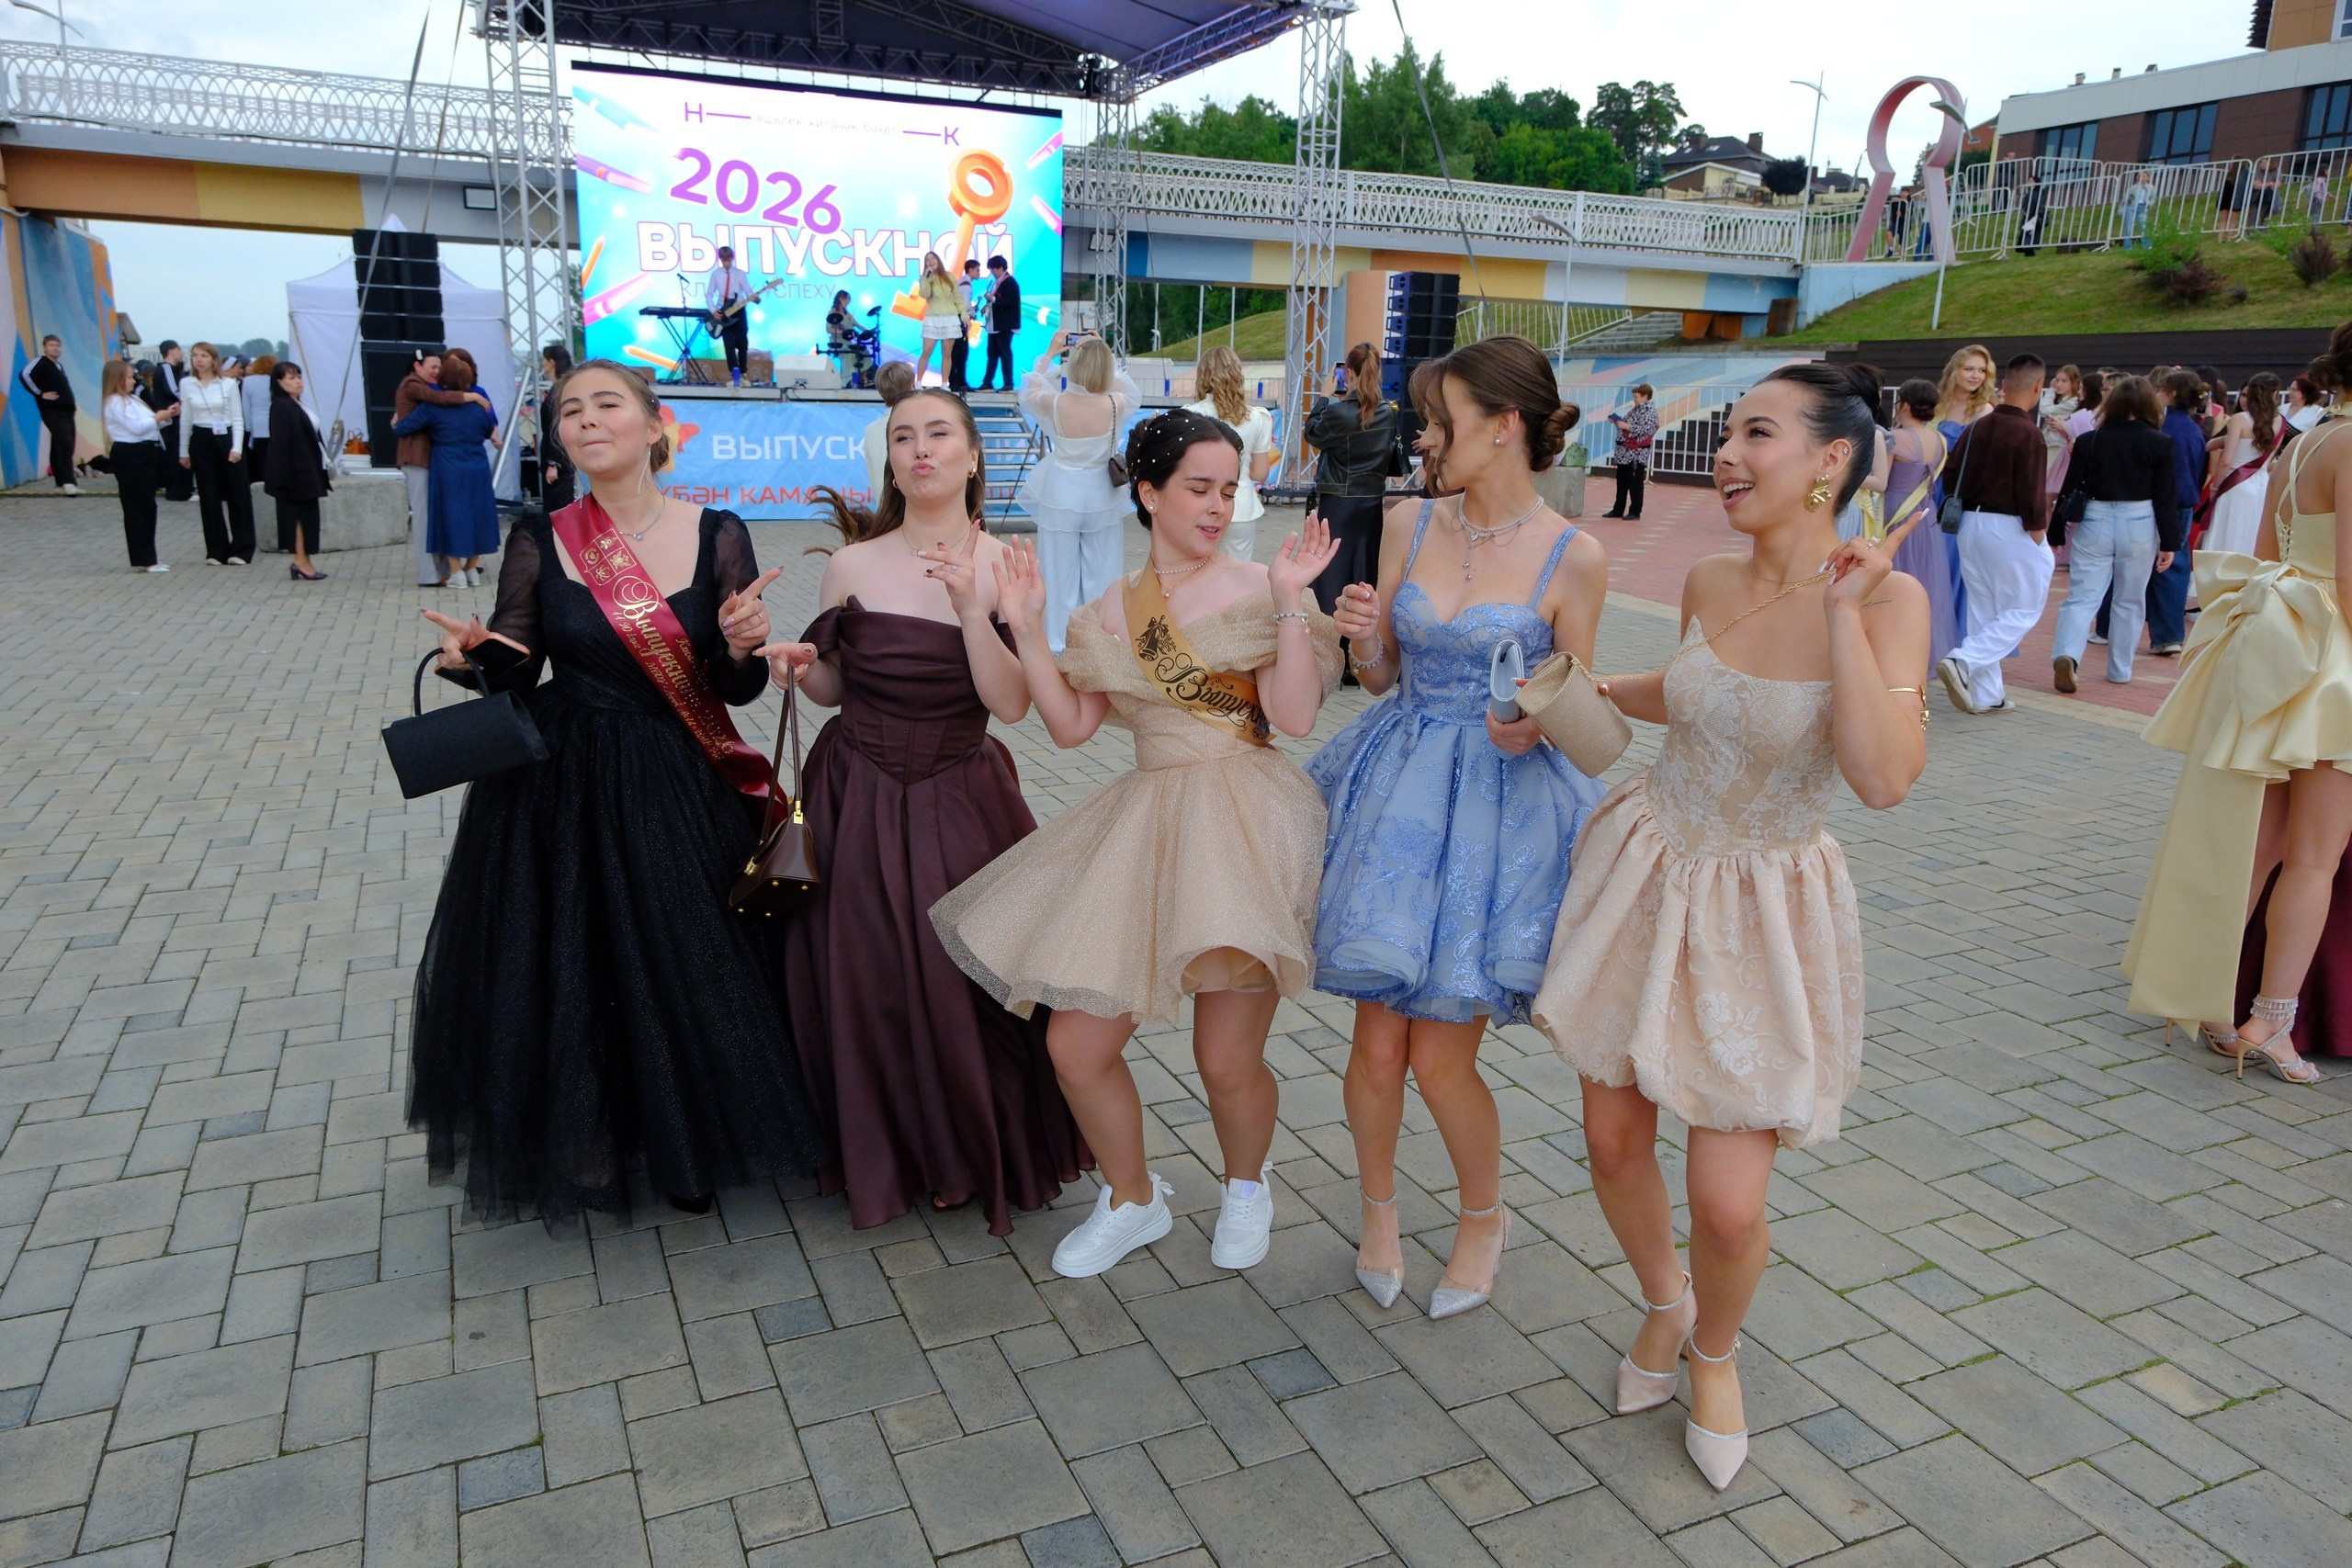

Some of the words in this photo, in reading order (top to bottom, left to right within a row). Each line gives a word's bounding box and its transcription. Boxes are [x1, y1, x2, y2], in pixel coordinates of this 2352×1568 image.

[944, 126, 960, 147] К
[671, 147, 842, 234] 2026
[637, 220, 1014, 279] ВЫПУСКНОЙ
